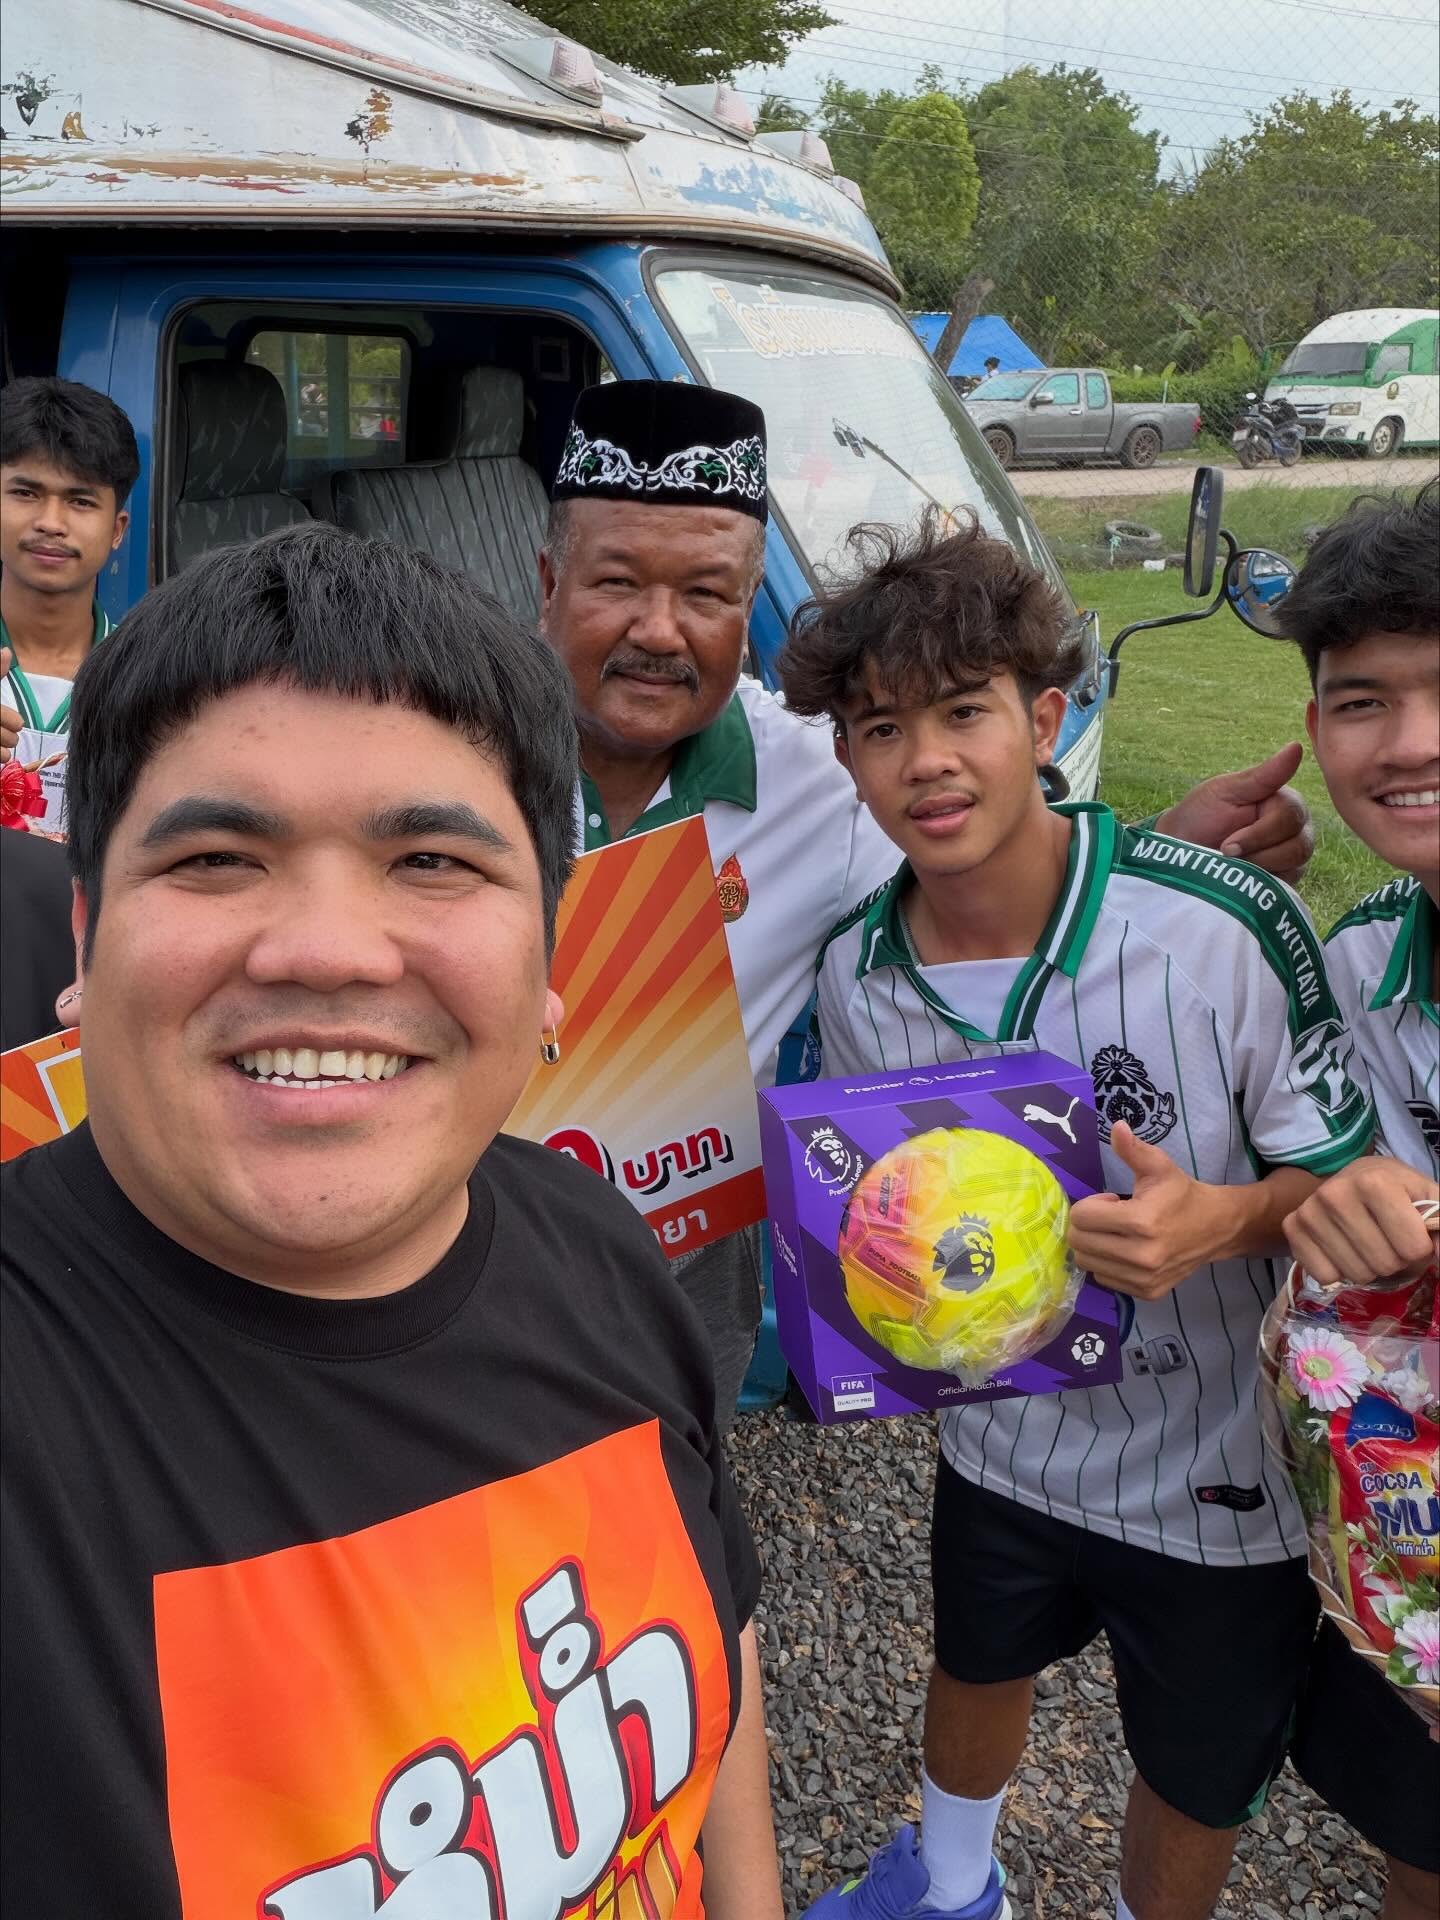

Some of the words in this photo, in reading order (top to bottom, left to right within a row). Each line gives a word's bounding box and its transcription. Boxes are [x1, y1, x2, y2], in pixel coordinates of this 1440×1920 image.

[1131, 838, 1277, 911] MONTHONG
[1275, 910, 1320, 1014] WITTAYA
[843, 1081, 905, 1095] Premier
[934, 1069, 997, 1082] League
[621, 1126, 728, 1192] บาท
[828, 1181, 855, 1197] Premier
[853, 1154, 864, 1182] League
[652, 1208, 709, 1245] ยา
[1083, 1339, 1093, 1352] 5
[840, 1380, 865, 1391] FIFA
[937, 1386, 968, 1397] Official
[996, 1378, 1012, 1388] Ball
[860, 1396, 873, 1404] PRO
[1361, 1471, 1423, 1493] COCOA
